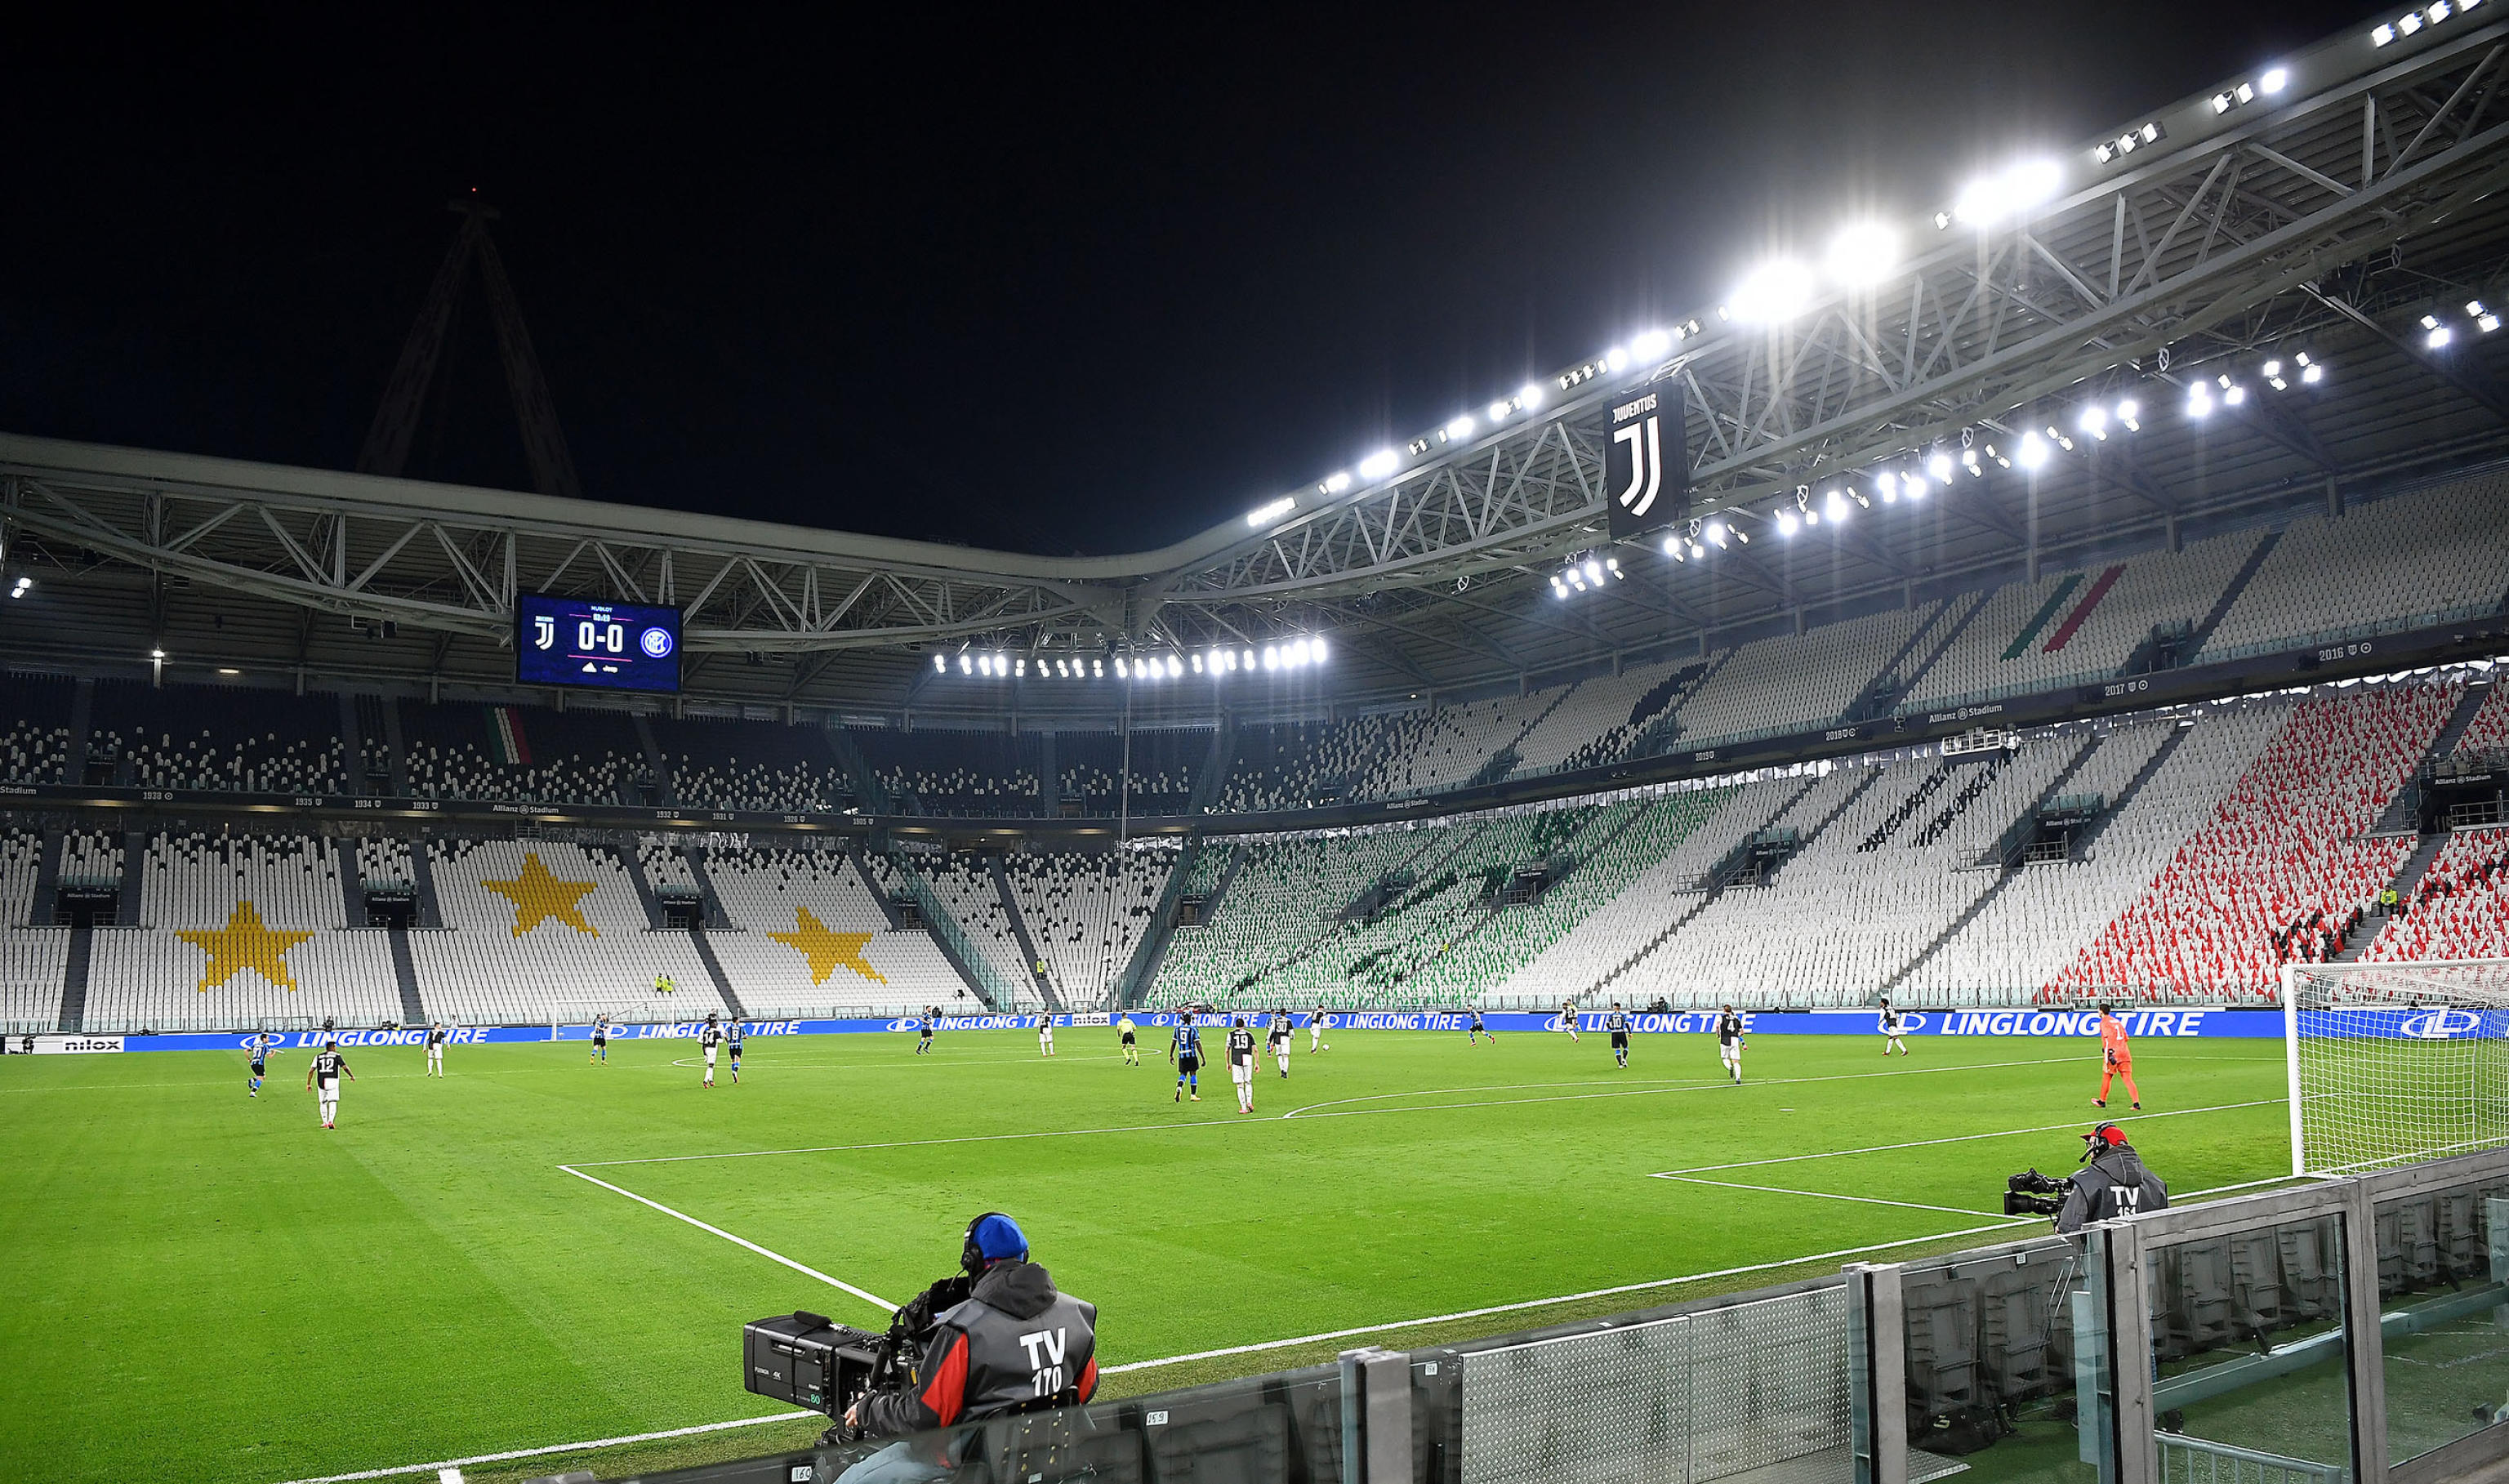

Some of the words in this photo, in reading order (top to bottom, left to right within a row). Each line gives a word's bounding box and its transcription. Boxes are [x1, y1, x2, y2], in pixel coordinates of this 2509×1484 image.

[1612, 393, 1657, 424] JUVENTUS
[578, 622, 623, 653] 0-0
[2319, 647, 2344, 662] 2016
[2106, 684, 2125, 696] 2017
[1929, 712, 1956, 724] Allianz
[1969, 705, 2002, 716] Stadium
[931, 1016, 1018, 1030] LINGLONG
[1073, 1015, 1107, 1024] nilox
[1345, 1014, 1419, 1029] LINGLONG
[1423, 1014, 1463, 1030] TIRE
[1612, 1017, 1621, 1028] 10
[1727, 1021, 1736, 1032] 4
[1941, 1013, 2101, 1036] LINGLONG
[2114, 1012, 2204, 1036] TIRE
[733, 1029, 739, 1041] 8
[751, 1021, 801, 1036] TIRE
[1276, 1022, 1287, 1033] 30
[2115, 1024, 2123, 1041] 1
[65, 1040, 120, 1050] nilox
[296, 1029, 424, 1047] LINGLONG
[704, 1032, 714, 1045] 14
[1180, 1032, 1187, 1045] 9
[1233, 1034, 1249, 1049] 19
[319, 1058, 334, 1072] 12
[2110, 1186, 2140, 1205] TV
[1019, 1327, 1066, 1370] TV
[1032, 1366, 1063, 1397] 170
